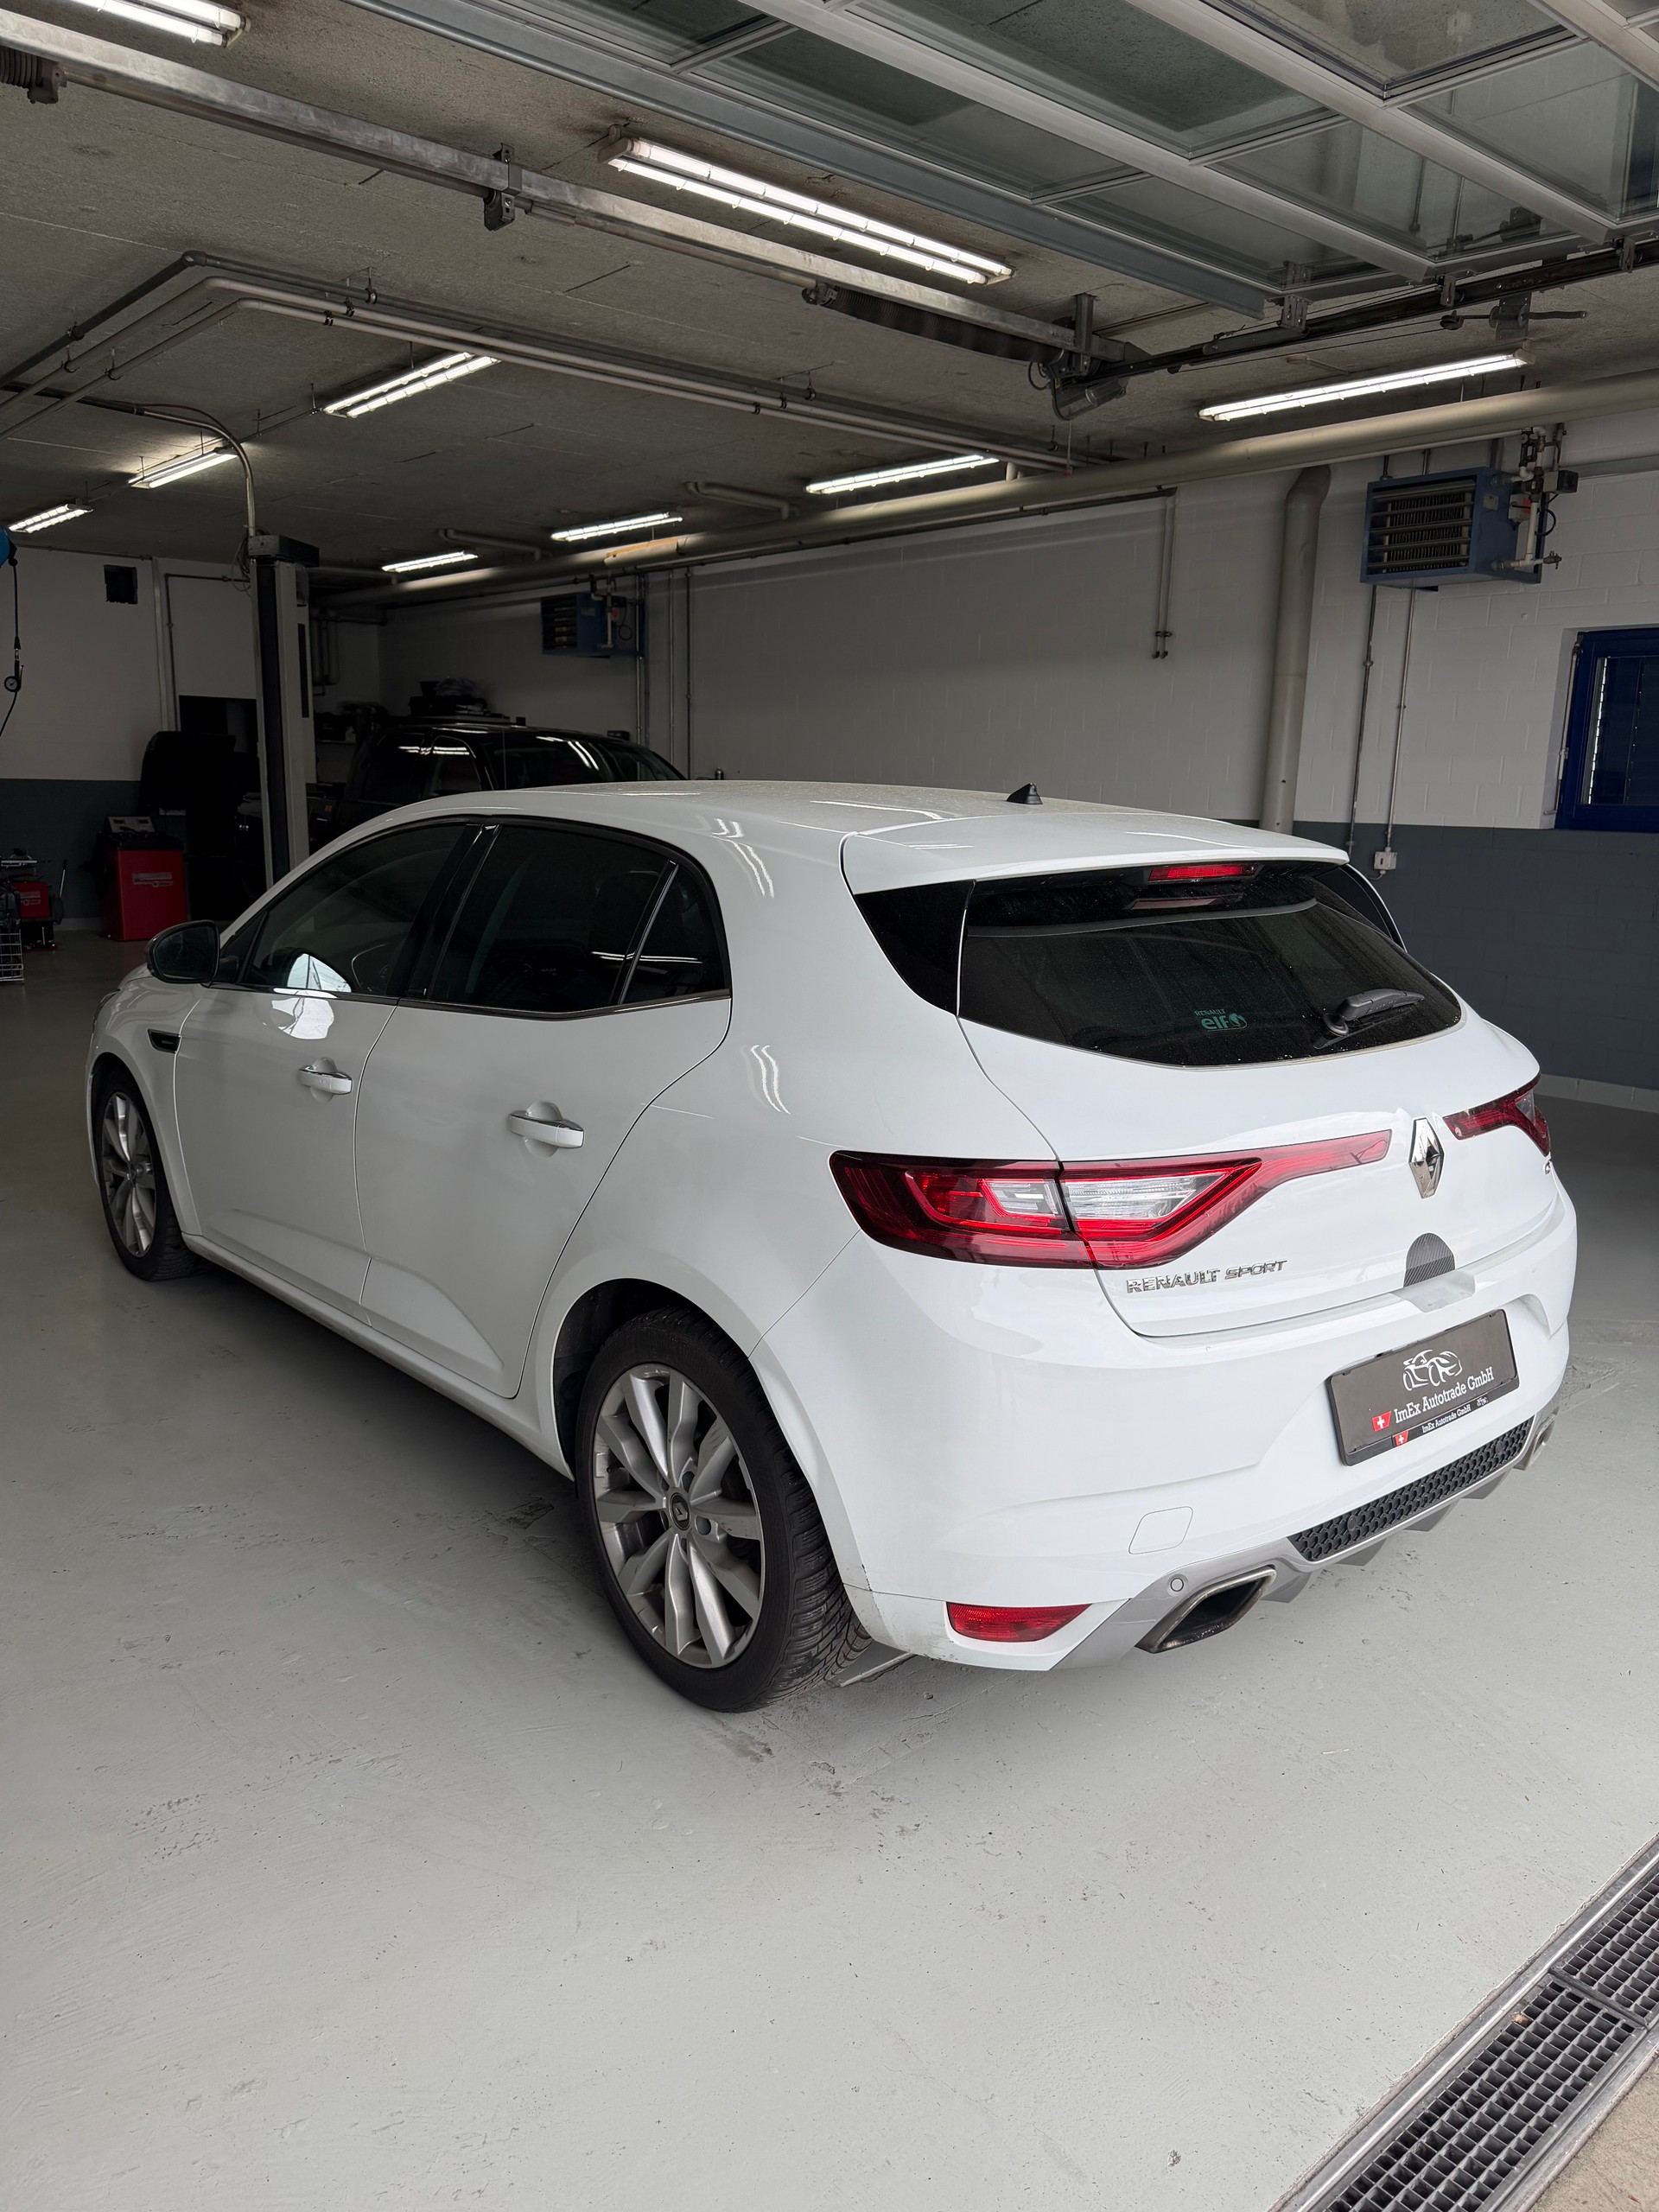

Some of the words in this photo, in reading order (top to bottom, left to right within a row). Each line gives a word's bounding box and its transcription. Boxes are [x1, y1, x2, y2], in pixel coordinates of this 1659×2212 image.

[1201, 1015, 1229, 1030] elf
[1126, 1268, 1220, 1294] RENAULT
[1224, 1259, 1287, 1280] SPORT
[1394, 1402, 1421, 1424] ImEx
[1422, 1382, 1466, 1412] Autotrade
[1467, 1366, 1494, 1390] GmbH
[1421, 1422, 1435, 1433] ImEx
[1435, 1412, 1457, 1427] Autotrade
[1457, 1404, 1471, 1416] GmbH
